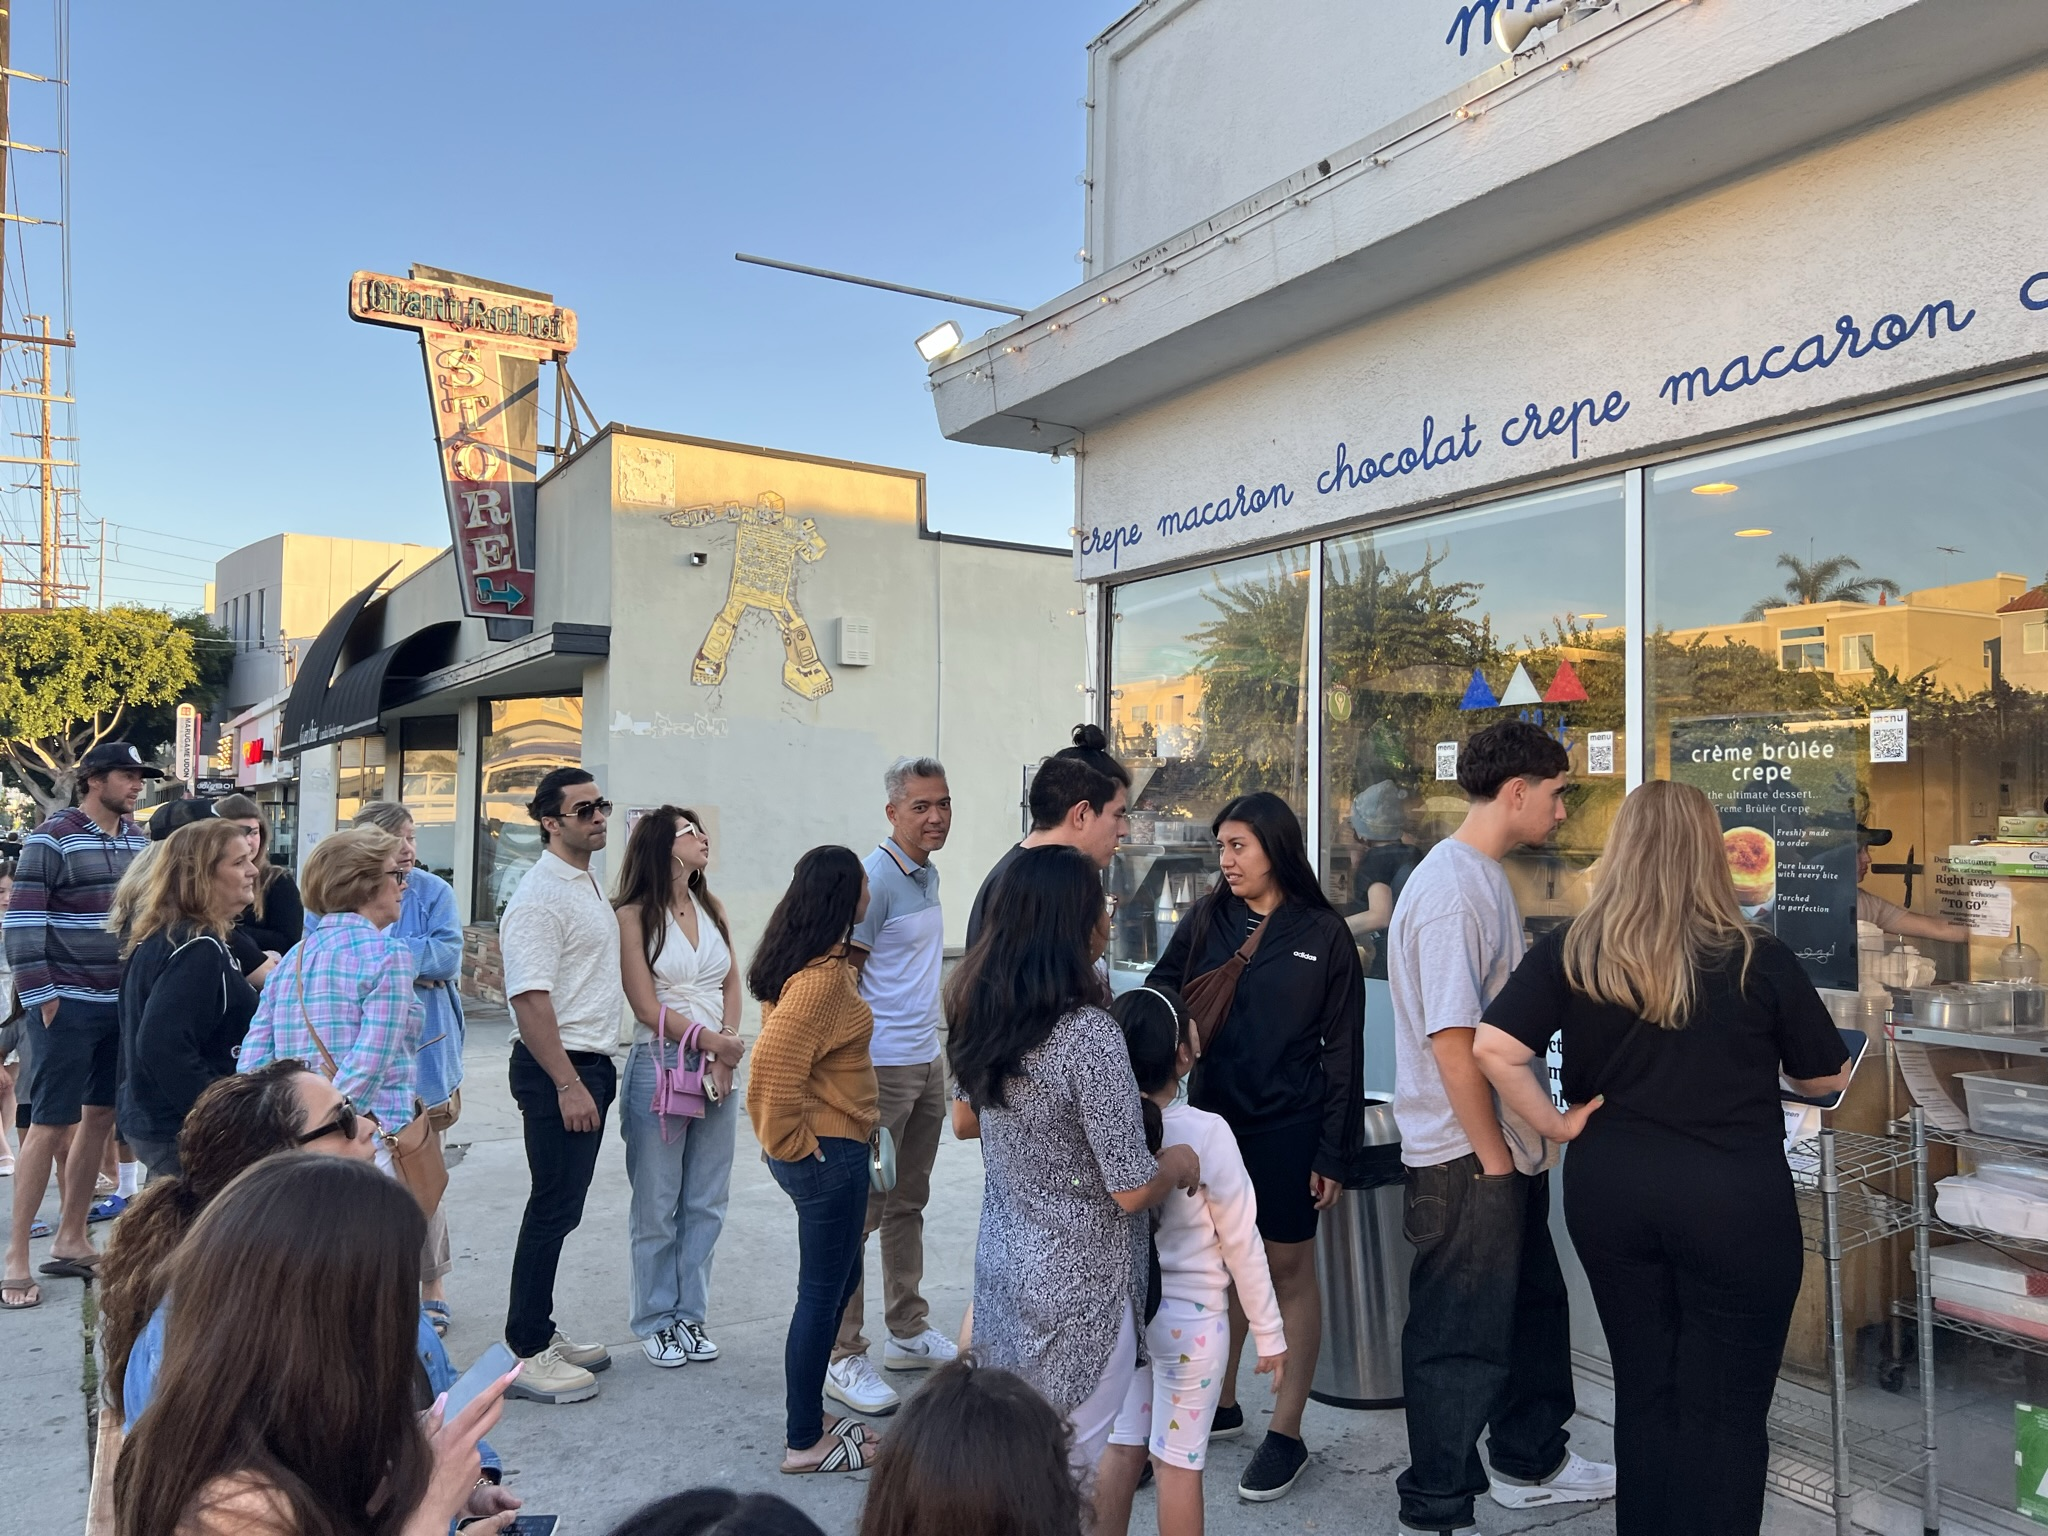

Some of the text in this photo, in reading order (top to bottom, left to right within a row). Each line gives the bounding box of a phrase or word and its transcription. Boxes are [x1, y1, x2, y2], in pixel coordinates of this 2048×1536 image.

[369, 279, 566, 343] Giant Robot
[1081, 523, 1143, 570] crepe
[1156, 483, 1295, 537] macaron
[1316, 413, 1482, 494] chocolat
[1501, 390, 1631, 459] crepe
[1658, 299, 1976, 405] macaron
[450, 347, 514, 576] STORE
[1874, 714, 1904, 724] menu
[183, 717, 192, 758] MARUGAME
[1589, 733, 1612, 741] menu
[1691, 739, 1835, 763] crème brûlée
[1732, 766, 1792, 785] crepe
[1707, 790, 1724, 800] the
[1726, 789, 1769, 800] ultimate
[1745, 803, 1777, 813] Brûlée
[1780, 803, 1811, 815] Crepe
[1776, 828, 1830, 838] Freshly made
[1786, 839, 1810, 847] order
[1777, 861, 1825, 871] Pure luxury
[1934, 856, 1997, 867] Dear Customers
[1777, 870, 1839, 880] with every bite
[1935, 874, 1997, 889] Right away
[1935, 888, 1956, 896] Please
[1777, 893, 1810, 902] Torched
[1787, 903, 1830, 913] perfection
[1293, 951, 1317, 961] adidas
